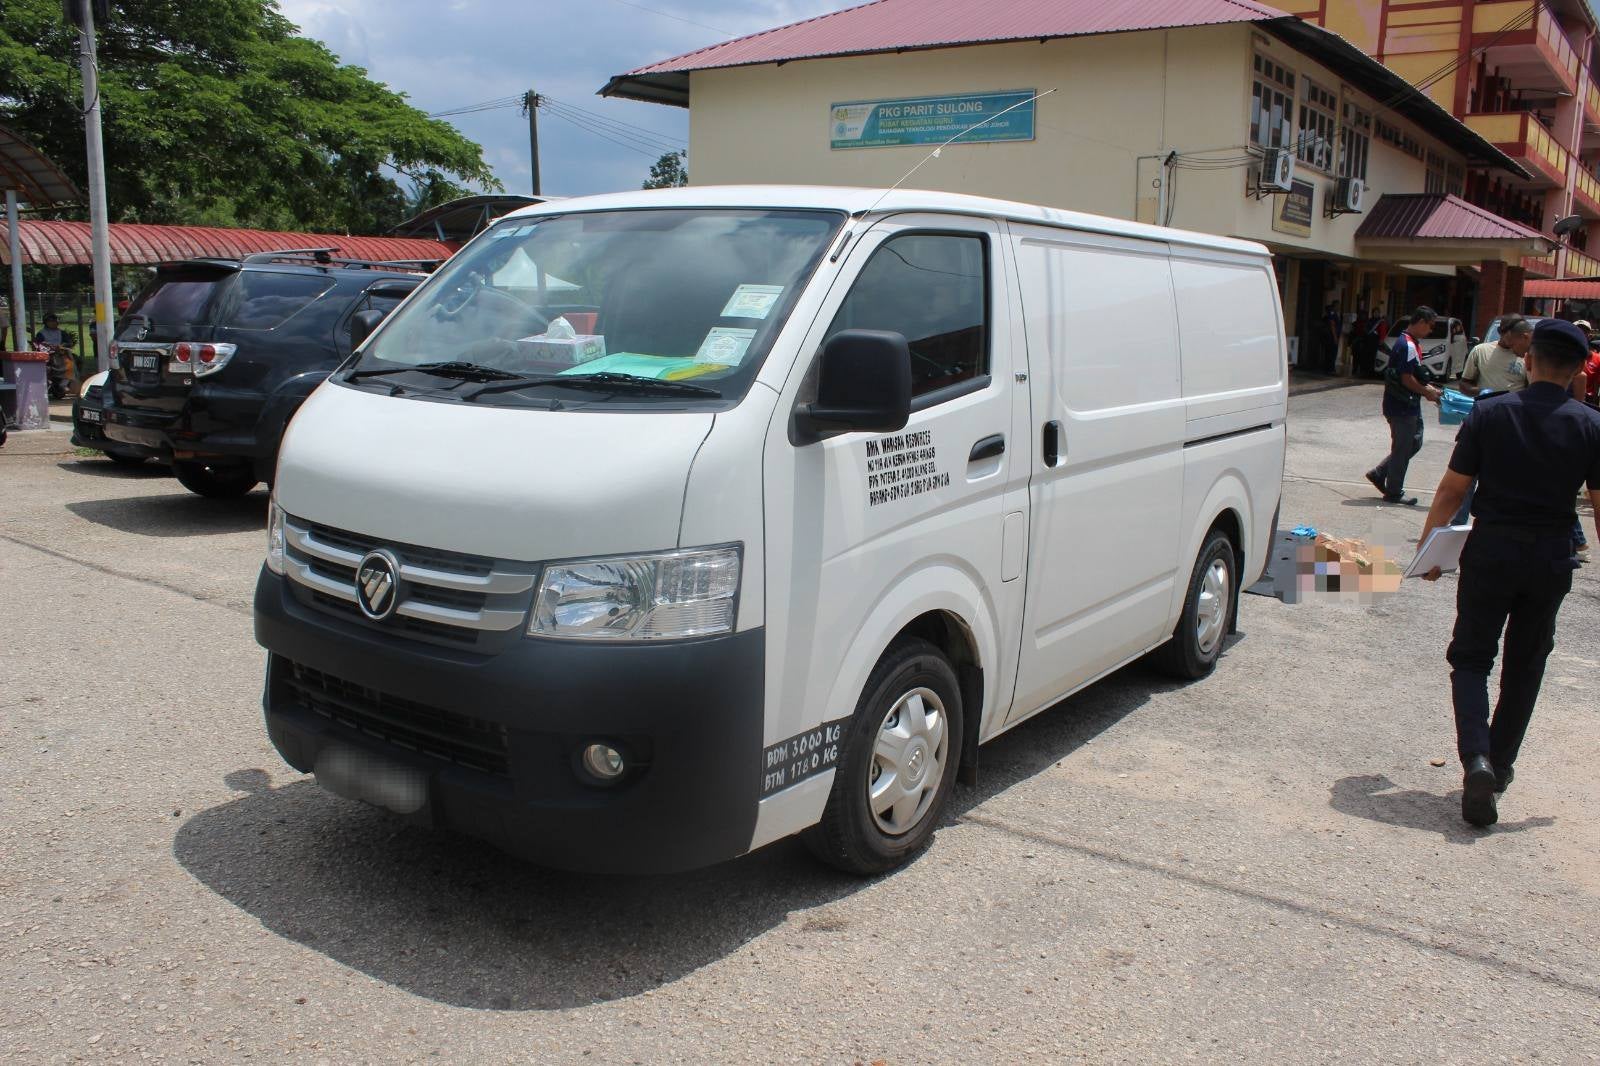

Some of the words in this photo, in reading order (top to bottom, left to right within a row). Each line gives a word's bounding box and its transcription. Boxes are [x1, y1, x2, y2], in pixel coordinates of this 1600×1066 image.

[879, 106, 900, 118] PKG
[903, 104, 934, 116] PARIT
[937, 101, 983, 114] SULONG
[879, 119, 899, 129] PUSAT
[900, 118, 933, 128] KEGIATAN
[933, 116, 953, 126] GURU
[767, 743, 788, 768] BDM
[792, 731, 822, 758] 3000
[825, 724, 841, 744] KG
[764, 767, 785, 791] BTM
[822, 744, 838, 765] KG
